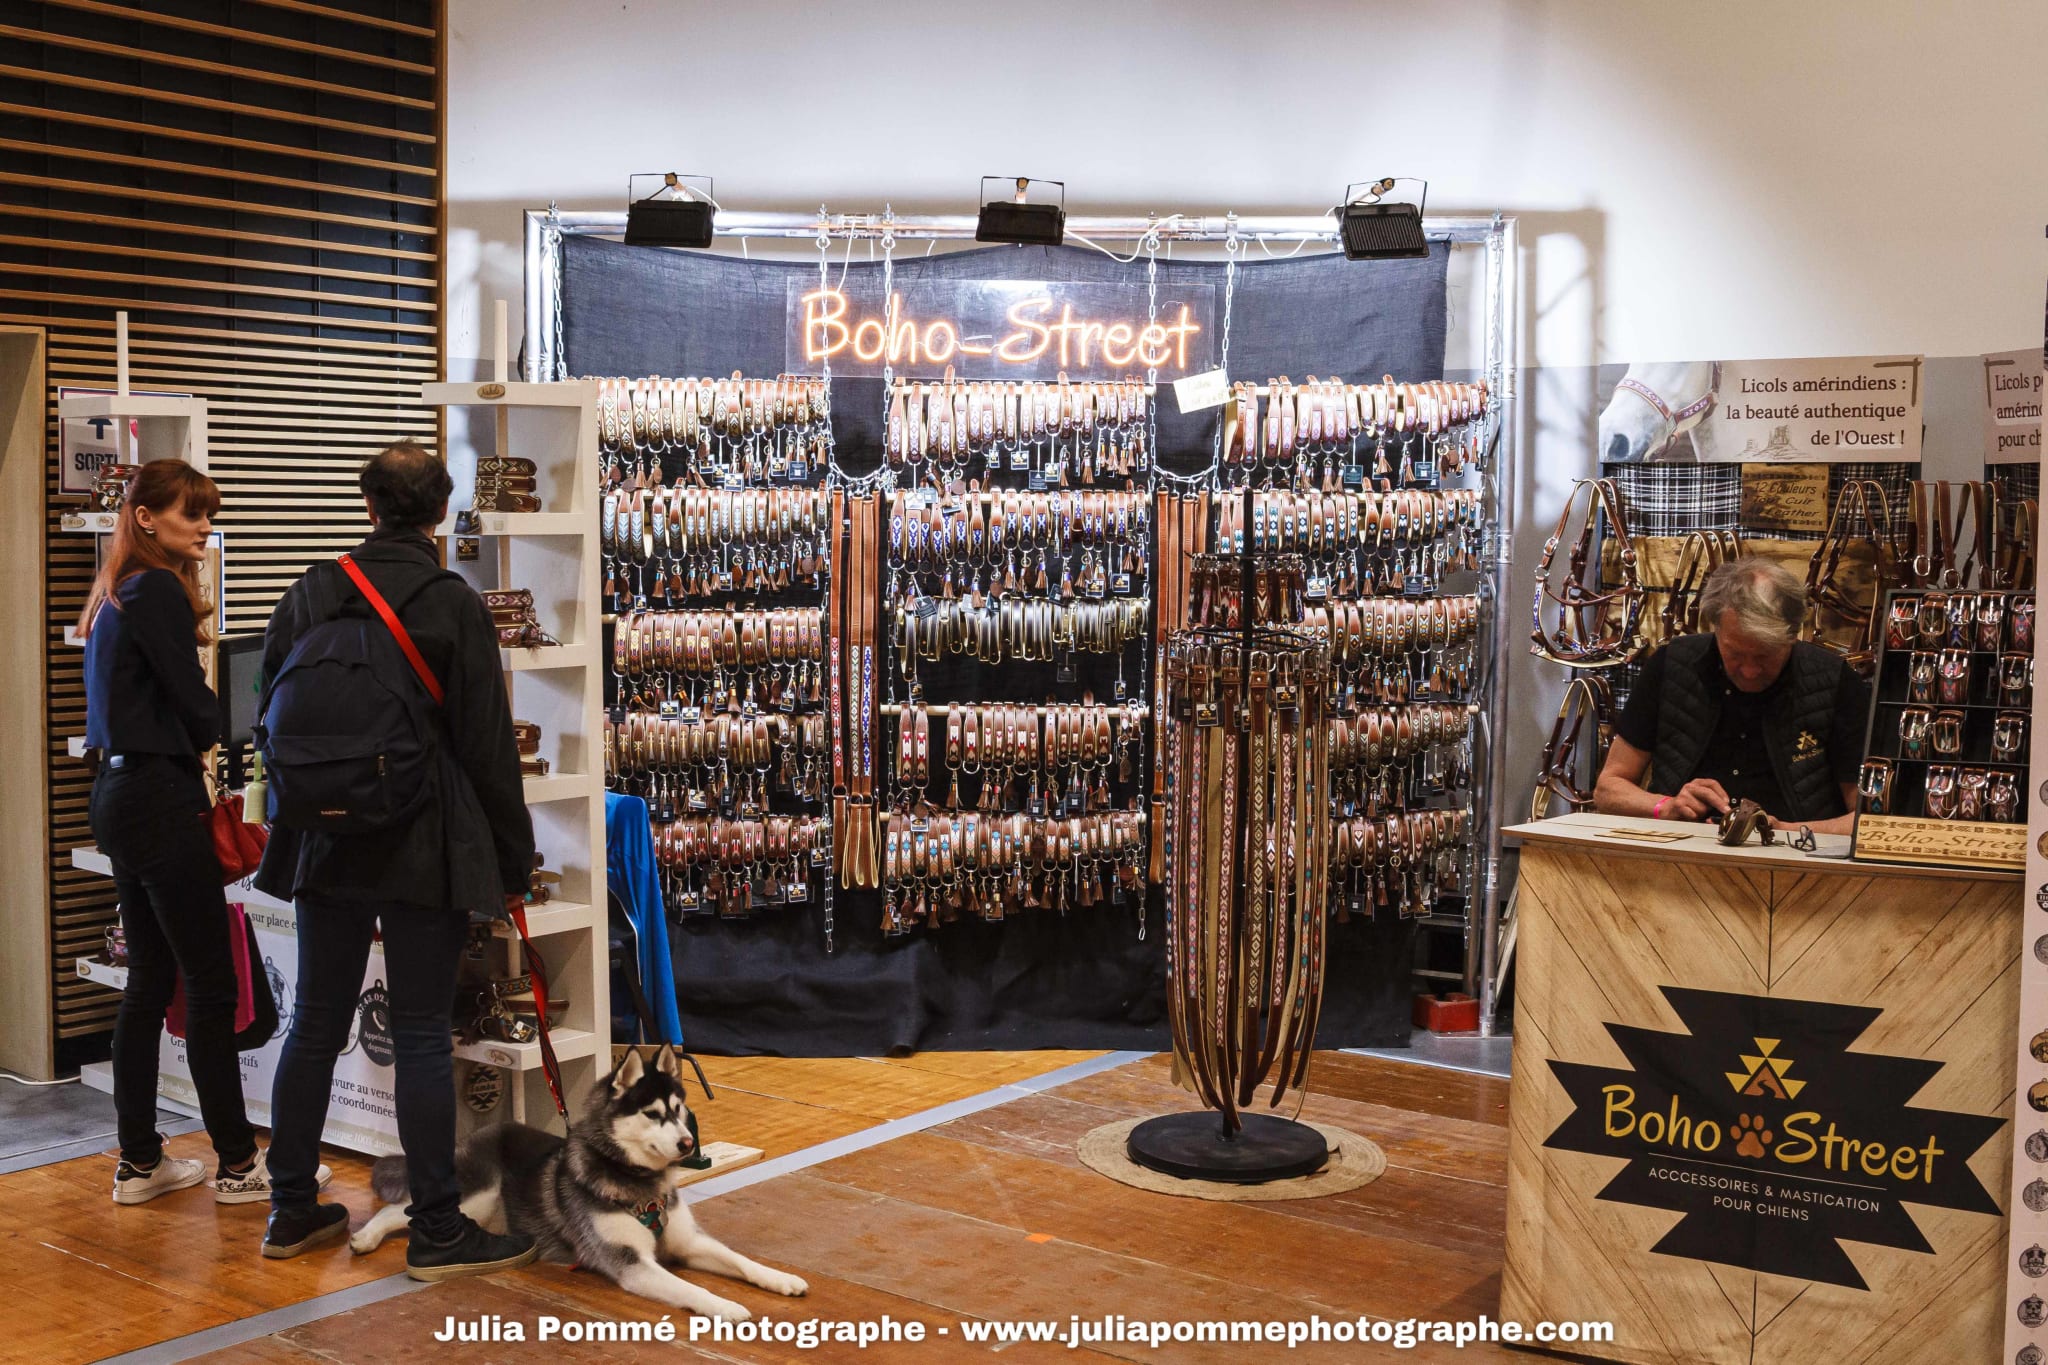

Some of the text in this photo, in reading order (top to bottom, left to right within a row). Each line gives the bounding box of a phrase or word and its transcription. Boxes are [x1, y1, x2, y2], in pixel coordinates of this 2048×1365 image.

[801, 288, 1200, 369] Boho-Street
[1741, 379, 1788, 393] Licols
[1792, 376, 1897, 393] amérindiens
[1995, 373, 2044, 392] Licols p
[1726, 401, 1906, 419] la beauté authentique
[1811, 428, 1905, 445] de l'Ouest !
[1998, 429, 2042, 451] pour ch
[75, 453, 118, 471] SORTI
[1754, 481, 1769, 493] 12
[1785, 496, 1815, 505] Cuir
[251, 912, 298, 930] sur place e
[170, 1035, 259, 1068] Gra otifs
[357, 1083, 369, 1095] au
[370, 1086, 395, 1102] verso
[1602, 1084, 1944, 1184] Boho Street
[1648, 1167, 1880, 1213] ACCCESSOIRES & MASTICATION
[1713, 1195, 1809, 1221] POUR CHIENS
